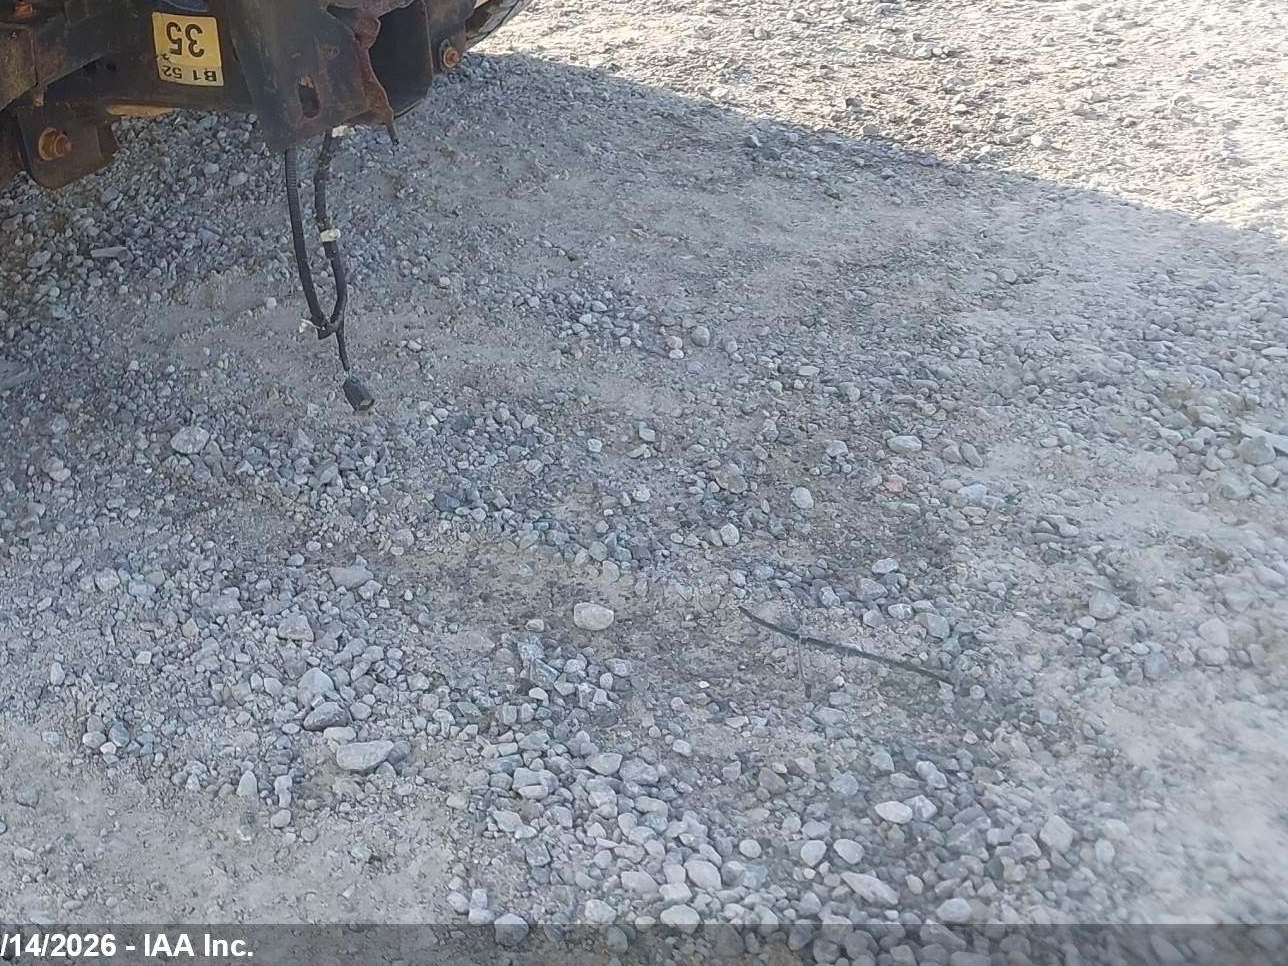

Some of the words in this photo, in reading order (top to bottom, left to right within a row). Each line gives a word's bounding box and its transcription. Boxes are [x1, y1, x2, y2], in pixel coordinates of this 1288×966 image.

[166, 21, 205, 58] 35
[162, 64, 183, 79] 52
[192, 69, 217, 82] B1
